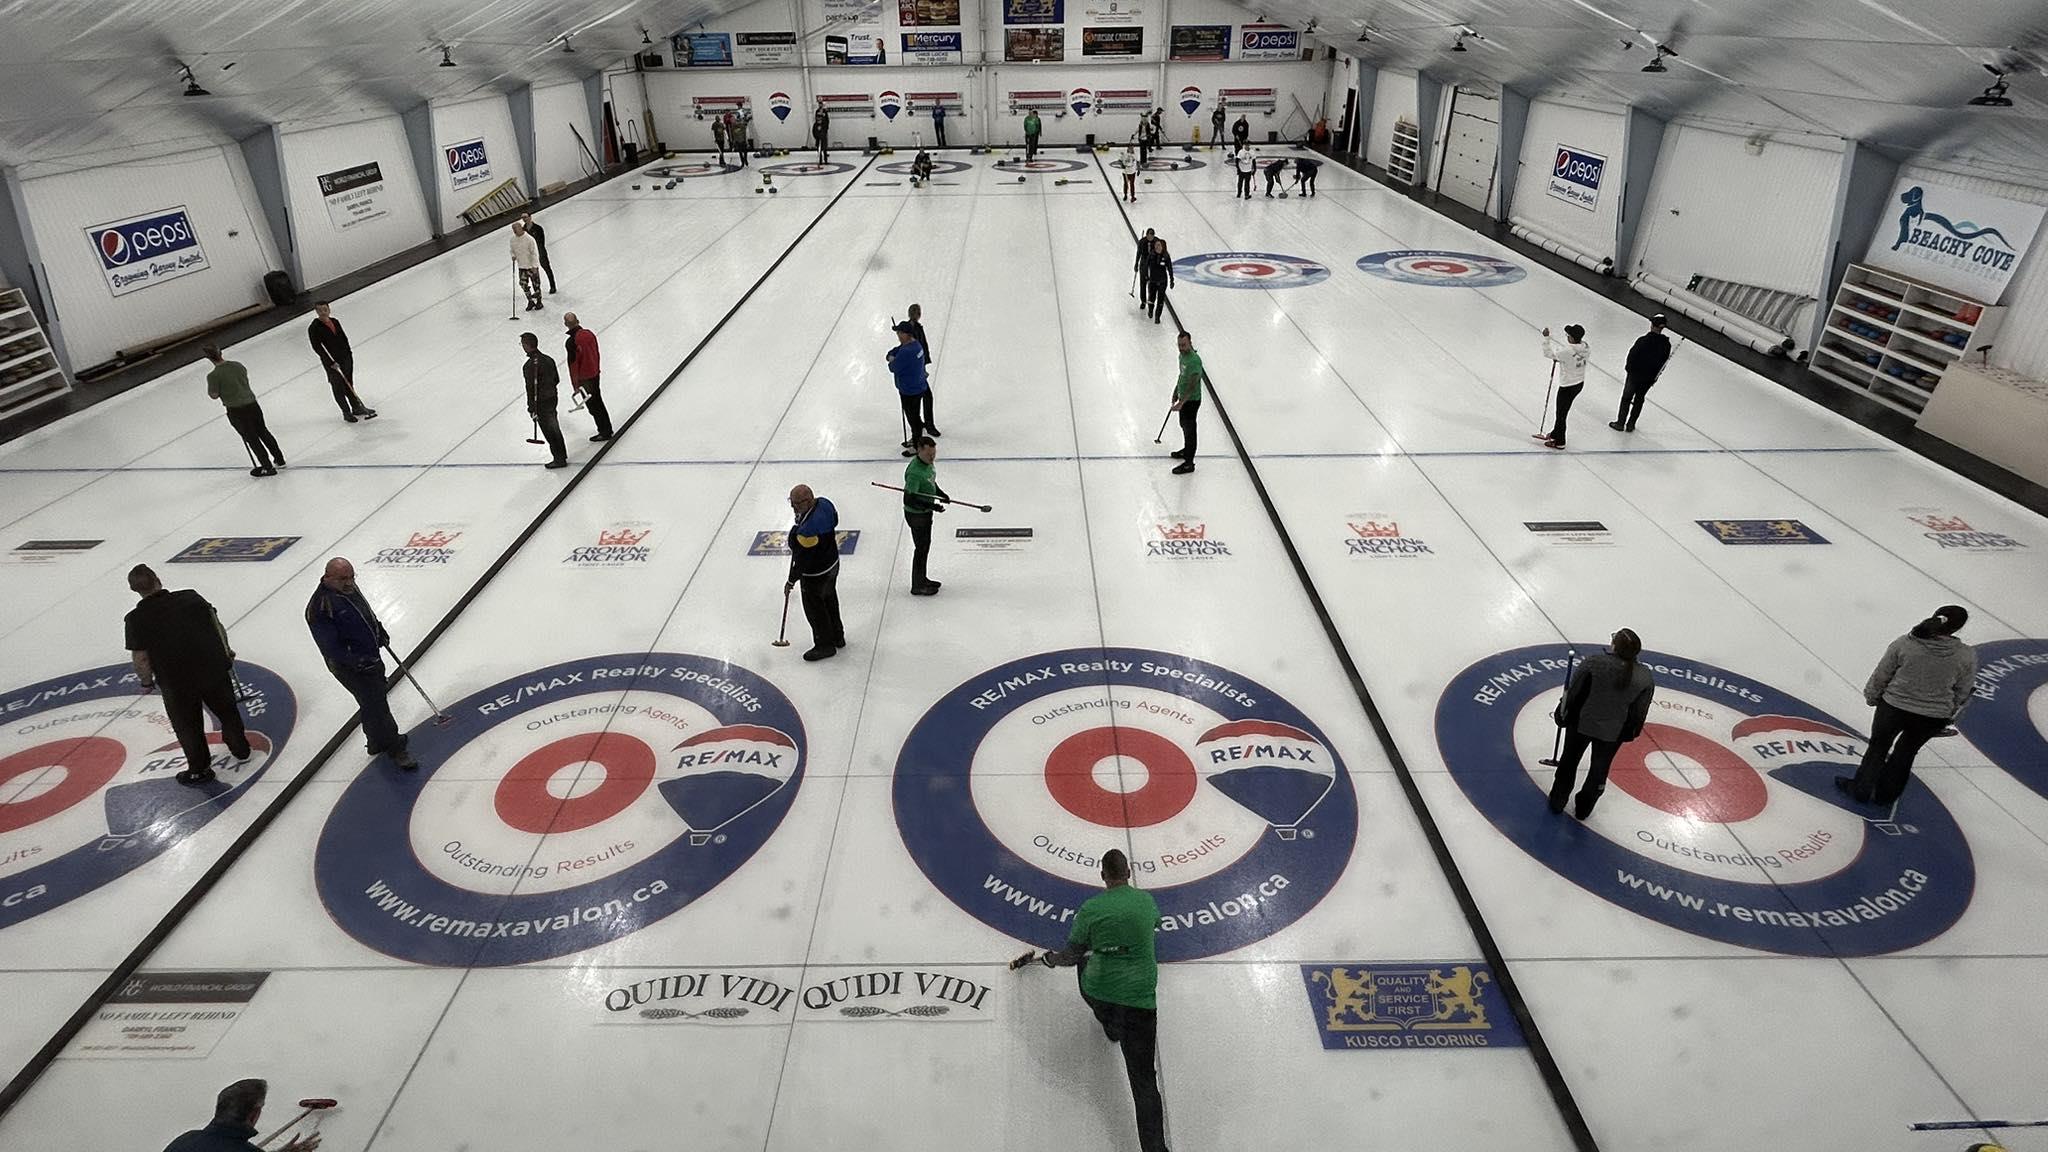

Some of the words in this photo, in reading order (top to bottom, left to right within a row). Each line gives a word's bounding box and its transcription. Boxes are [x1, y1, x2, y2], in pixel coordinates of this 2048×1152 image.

[914, 34, 956, 43] Mercury
[1261, 31, 1295, 47] pepsi
[461, 146, 486, 168] pepsi
[1568, 163, 1602, 183] pepsi
[132, 216, 191, 256] pepsi
[1908, 228, 1973, 258] BEACHY
[1972, 245, 2015, 272] COVE
[364, 556, 451, 565] ANCHOR
[562, 553, 648, 562] ANCHOR
[1147, 547, 1233, 557] ANCHOR
[1348, 544, 1435, 555] ANCHOR
[478, 671, 583, 716] RE/MAX
[591, 664, 666, 680] Realty
[670, 667, 763, 713] Specialists
[970, 666, 1057, 711] RE/MAX
[1061, 659, 1134, 676] Realty
[1140, 662, 1257, 709] Specialists
[1473, 663, 1543, 706] RE/MAX
[1972, 658, 2022, 701] RE/MAX
[18, 708, 142, 735] Outstanding
[526, 703, 637, 731] Outstanding
[640, 706, 689, 730] Agents
[1032, 698, 1132, 726] Outstanding
[1136, 700, 1195, 726] Agents
[1651, 699, 1715, 721] gents
[677, 750, 782, 769] RE/MAX
[1211, 745, 1315, 764] RE/MAX
[1752, 740, 1865, 760] RE/MAX
[443, 840, 549, 879] Outstanding
[556, 838, 636, 875] Results
[1033, 834, 1156, 873] Outstang
[1160, 832, 1226, 868] Results
[1636, 829, 1782, 869] Outstanding
[1778, 828, 1833, 864] Results
[364, 879, 669, 939] www.remaxavalon.ca
[983, 872, 1291, 933] www.ravalon.ca
[1617, 867, 1929, 929] www.remaxavalon.ca
[604, 973, 710, 1012] QUIDI
[720, 974, 796, 1013] VIDI
[802, 971, 904, 1010] QUIDI
[914, 972, 992, 1011] VIDI
[1377, 976, 1427, 986] QUALITY
[1378, 995, 1429, 1004] SERVICE
[1387, 1006, 1421, 1015] FIRST
[158, 1012, 191, 1020] LEFT
[189, 1012, 236, 1020] BEHIND
[1345, 1036, 1401, 1047] KUSCO
[1406, 1034, 1488, 1047] FLOORING
